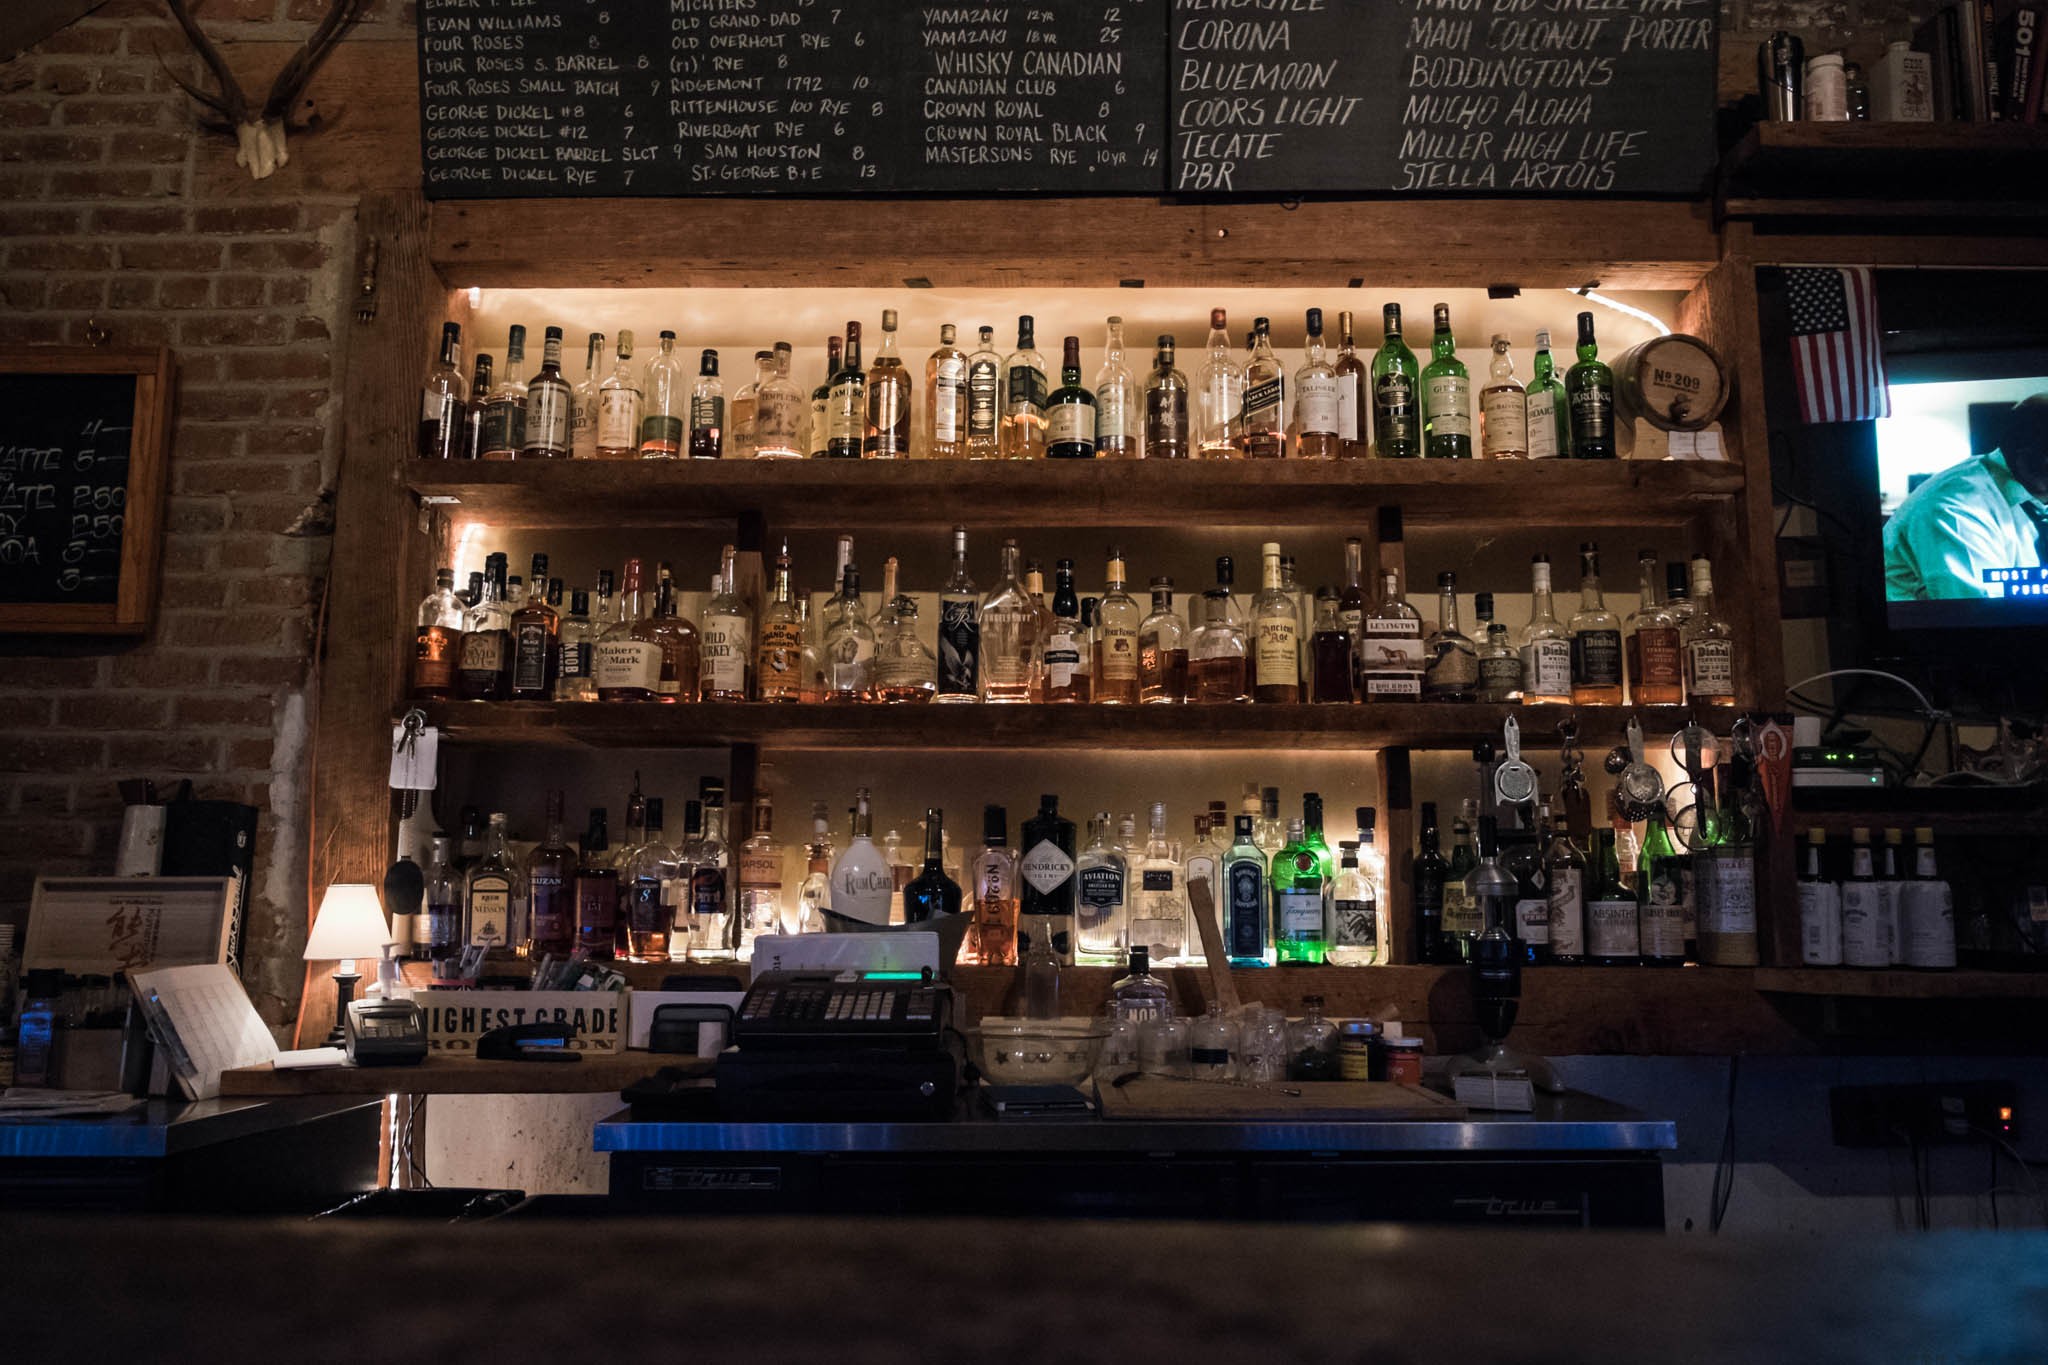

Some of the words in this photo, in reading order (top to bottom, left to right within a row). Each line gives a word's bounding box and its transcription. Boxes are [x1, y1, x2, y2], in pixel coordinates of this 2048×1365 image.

[426, 17, 470, 32] EVAN
[478, 14, 562, 31] WILLIAMS
[671, 18, 699, 31] OLD
[831, 9, 841, 24] 7
[922, 8, 1009, 26] YAMAZAKI
[1103, 8, 1121, 22] 12
[672, 36, 699, 49] OLD
[710, 34, 786, 48] OVERHOLT
[801, 33, 832, 50] RYE
[854, 32, 865, 47] 6
[922, 29, 1007, 47] YAMAZAKI
[1099, 26, 1123, 43] 25
[1178, 19, 1290, 51] CORONA
[1406, 16, 1472, 51] MAUI
[1622, 16, 1713, 52] PORTER
[2016, 8, 2035, 56] 501
[424, 36, 464, 53] FOUR
[472, 35, 524, 51] ROSES
[425, 57, 465, 73] FOUR
[476, 55, 524, 72] ROSES
[555, 54, 620, 71] BARREL
[712, 55, 745, 71] RYE
[778, 54, 789, 69] 8
[935, 50, 1014, 75] WHISKY
[1023, 51, 1121, 76] CANADIAN
[1408, 54, 1617, 88] BODDINGTONS
[424, 80, 462, 98] FOUR
[465, 79, 511, 94] ROSES
[518, 78, 566, 93] SMALL
[574, 79, 620, 96] BATCH
[651, 80, 661, 96] 9
[670, 77, 764, 94] RIDGEMONT
[786, 77, 824, 92] 1792
[853, 75, 869, 90] 10
[924, 78, 1007, 95] CANADIAN
[1016, 79, 1056, 96] CLUB
[1115, 79, 1126, 95] 6
[426, 104, 488, 120] GEORGE
[496, 105, 554, 120] DICKEL
[624, 104, 633, 117] 6
[670, 99, 778, 116] RITTENHOUSE
[790, 99, 812, 113] 100
[819, 98, 851, 116] RYE
[871, 101, 884, 116] 8
[923, 100, 986, 119] CROWN
[995, 101, 1044, 119] ROYAL
[1098, 101, 1110, 118] 8
[1179, 98, 1265, 128] COORS
[1274, 95, 1364, 126] LIGHT
[1402, 94, 1499, 126] MUCHO
[1505, 90, 1592, 126] ALOHA
[427, 126, 488, 141] GEORGE
[494, 125, 551, 139] DICKEL
[559, 126, 589, 140] #12
[624, 125, 634, 140] 7
[678, 121, 760, 139] RIVERBOAT
[774, 122, 805, 138] RYE
[834, 121, 845, 136] 6
[925, 124, 987, 143] CROWN
[996, 125, 1044, 143] ROYAL
[1052, 122, 1108, 143] BLACK
[1134, 123, 1145, 144] 9
[427, 146, 488, 161] GEORGE
[495, 146, 549, 160] DICKEL
[556, 148, 612, 162] BARREL
[622, 146, 659, 161] SLCT
[673, 145, 682, 159] 9
[704, 144, 738, 160] SAM
[747, 143, 821, 160] HOUSTON
[852, 145, 865, 160] 8
[1177, 131, 1283, 160] TECATE
[1397, 129, 1494, 161] MILLER
[1503, 130, 1569, 162] HIGH
[1579, 130, 1648, 161] LIFE
[926, 146, 1033, 164] MASTERSONS
[1050, 148, 1077, 165] RYE
[1142, 148, 1159, 167] 14
[429, 167, 492, 182] GEORGE
[502, 167, 558, 182] DICKEL
[566, 169, 597, 186] RYE
[624, 170, 634, 185] 7
[721, 164, 780, 180] GEORGE
[860, 164, 877, 178] 13
[1178, 161, 1236, 191] PBR
[1391, 161, 1495, 191] STELLA
[1510, 160, 1617, 191] ARTOIS
[1675, 374, 1700, 389] 209
[705, 632, 726, 643] WILD
[565, 642, 579, 673] KNOB
[609, 656, 641, 664] Mark
[1083, 872, 1121, 881] AVIATION
[1593, 909, 1635, 919] ABSINTHE
[536, 1007, 617, 1034] GRADE
